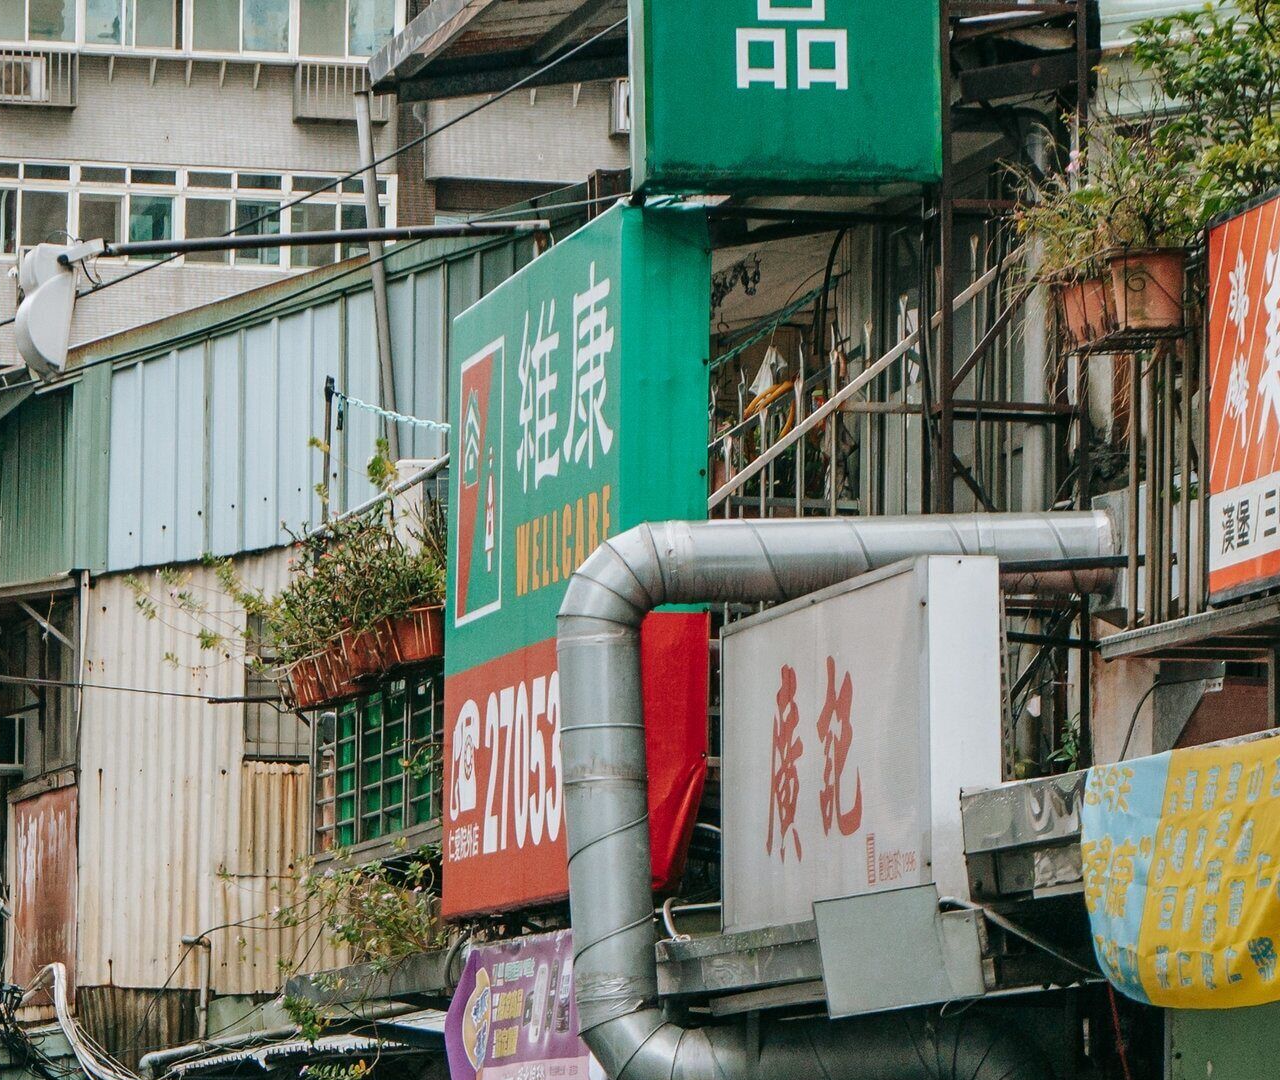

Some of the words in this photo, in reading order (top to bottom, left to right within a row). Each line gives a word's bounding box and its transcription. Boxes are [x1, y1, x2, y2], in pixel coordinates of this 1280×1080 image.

[735, 0, 848, 91] 品
[516, 261, 614, 495] 維康
[515, 484, 611, 597] WELLCARE
[483, 670, 566, 854] 27053
